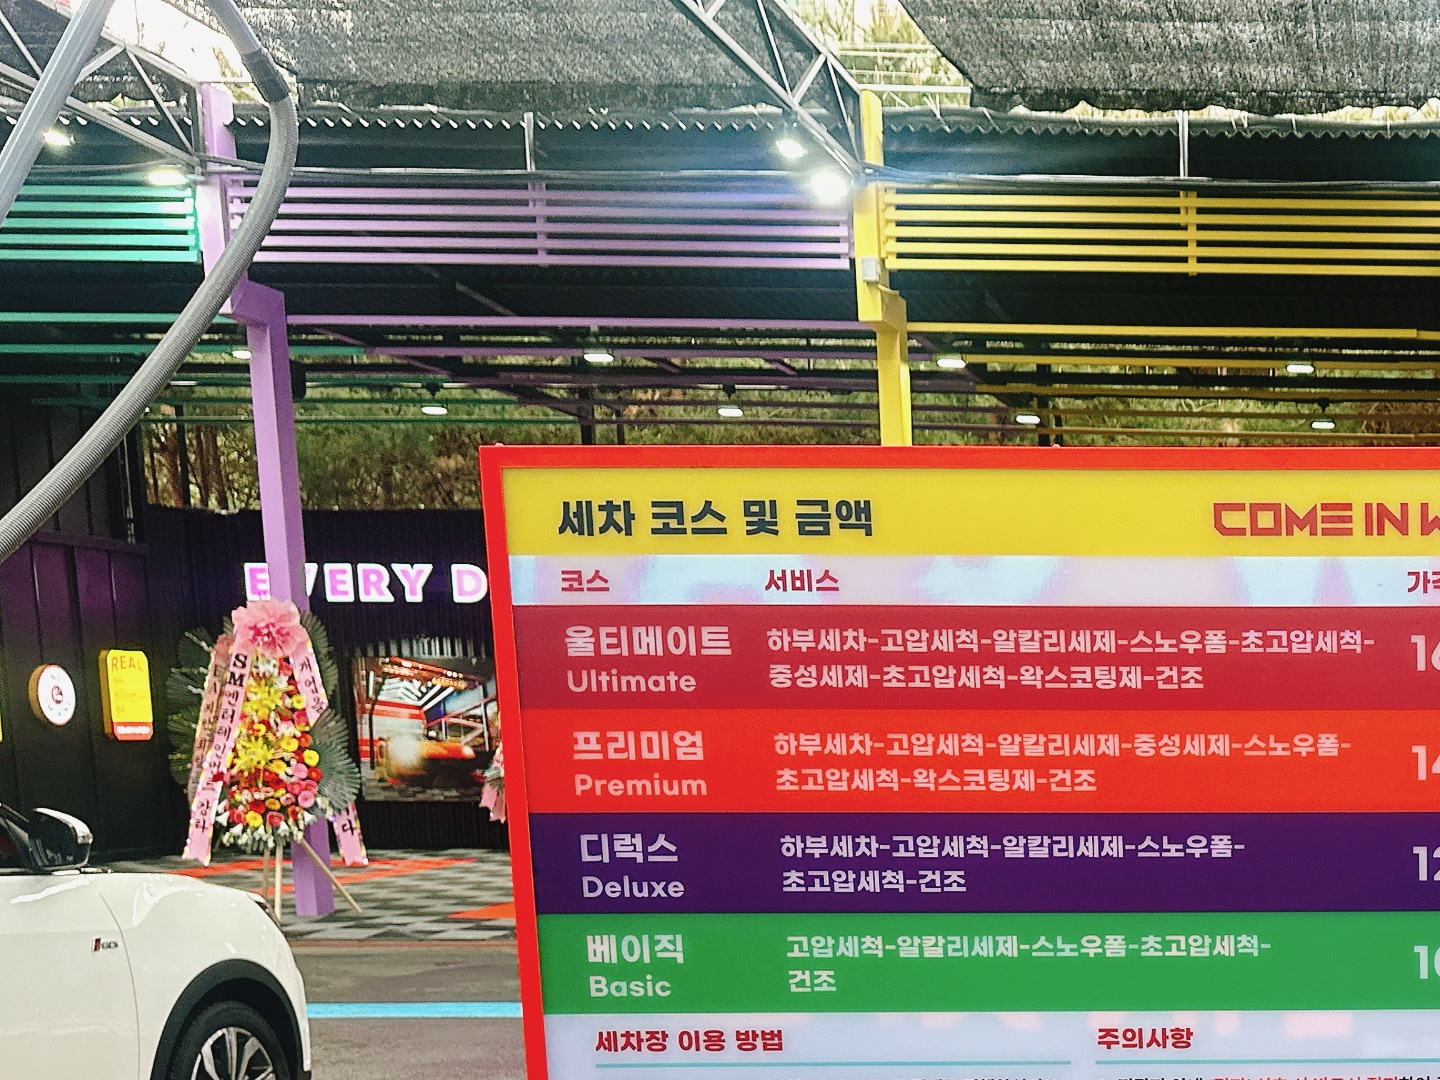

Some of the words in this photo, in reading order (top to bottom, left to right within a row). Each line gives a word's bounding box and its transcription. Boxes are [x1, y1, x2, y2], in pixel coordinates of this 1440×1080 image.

[559, 500, 635, 536] 세차
[651, 500, 727, 534] 코스
[743, 500, 779, 536] 및
[795, 500, 872, 536] 금액
[1213, 503, 1353, 536] COME
[1365, 503, 1409, 536] IN
[562, 570, 609, 592] 코스
[765, 569, 839, 592] 서비스
[565, 626, 731, 656] 울티메이트
[111, 655, 145, 673] REAL
[568, 669, 696, 692] Ultimate
[574, 731, 703, 760] 프리미엄
[575, 773, 707, 795] Premium
[580, 834, 678, 863] 디럭스
[582, 875, 684, 897] Deluxe
[587, 935, 684, 963] 베이직
[590, 975, 671, 997] Basic
[789, 970, 836, 992] 건조
[596, 1031, 668, 1052] 세차장
[679, 1030, 725, 1051] 이용
[736, 1030, 783, 1051] 방법
[1098, 1028, 1193, 1049] 주의사항
